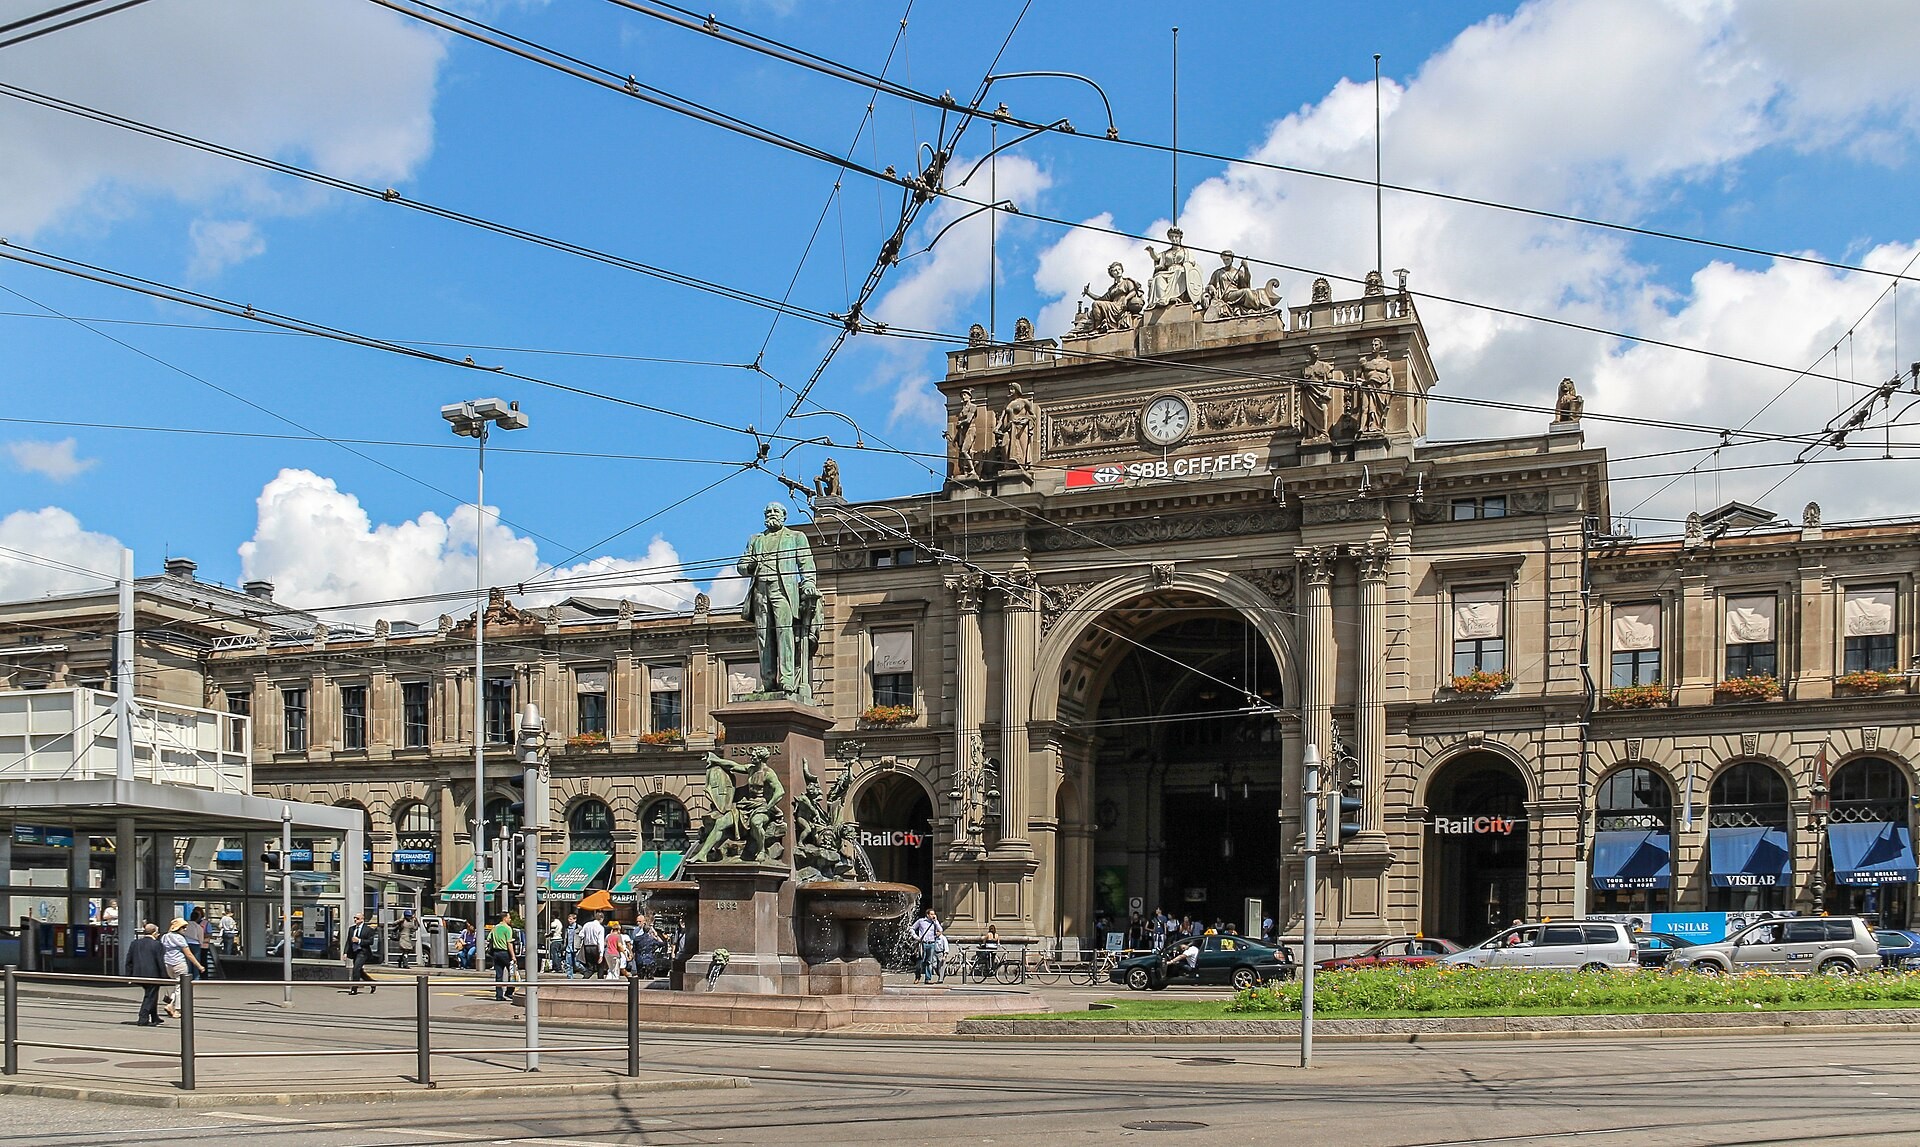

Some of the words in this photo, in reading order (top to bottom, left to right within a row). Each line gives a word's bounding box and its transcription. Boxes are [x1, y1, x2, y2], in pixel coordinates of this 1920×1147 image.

[1129, 461, 1169, 479] SBB
[1173, 452, 1258, 476] CFF/FFS
[1434, 815, 1514, 835] RailCity
[860, 829, 924, 848] RailCity
[1726, 874, 1776, 886] VISILAB
[1667, 922, 1709, 931] VISILAB
